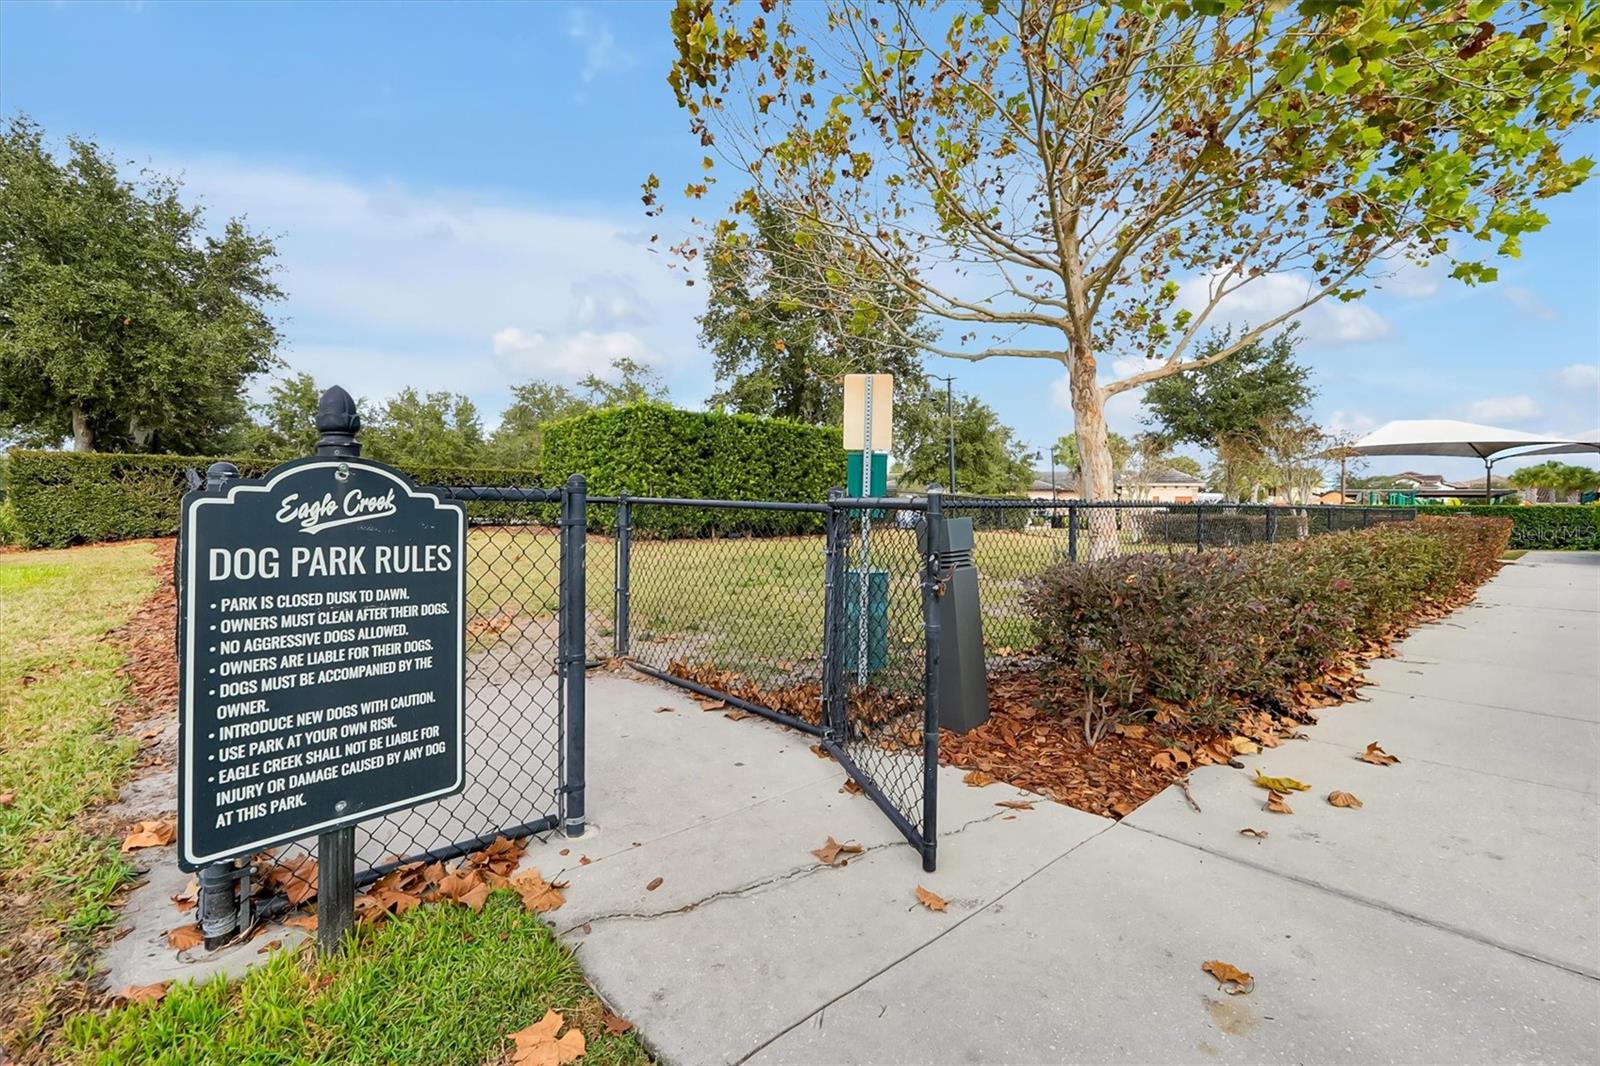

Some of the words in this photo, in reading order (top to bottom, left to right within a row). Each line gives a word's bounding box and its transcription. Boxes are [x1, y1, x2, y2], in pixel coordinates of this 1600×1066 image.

[275, 492, 338, 527] Eagle
[342, 488, 397, 517] Creek
[208, 547, 280, 581] DOG
[291, 545, 367, 578] PARK
[374, 544, 452, 575] RULES
[220, 597, 256, 613] PARK
[260, 596, 274, 610] IS
[277, 592, 323, 609] CLOSED
[325, 591, 357, 606] DUSK
[358, 590, 374, 603] TO
[375, 588, 410, 602] DAWN.
[220, 615, 278, 634] OWNERS
[280, 613, 315, 629] MUST
[317, 609, 354, 625] CLEAN
[356, 606, 388, 621] AFTER
[389, 605, 419, 618] THEIR
[420, 602, 450, 616] DOGS.
[219, 659, 277, 677] OWNERS
[280, 654, 304, 669] ARE
[307, 649, 345, 666] LIABLE
[348, 647, 370, 661] FOR
[371, 644, 402, 658] THEIR
[403, 639, 434, 655] DOGS.
[220, 639, 241, 655] NO
[243, 632, 321, 653] AGGRESSIVE
[324, 629, 356, 644] DOGS
[357, 624, 409, 641] ALLOWED.
[219, 680, 258, 698] DOGS
[261, 675, 297, 692] MUST
[299, 672, 315, 687] BE
[317, 662, 396, 685] ACCOMPANIED
[398, 657, 413, 673] BY
[414, 654, 433, 669] THE
[216, 699, 270, 720] OWNER.
[219, 715, 294, 742] INTRODUCE
[296, 709, 324, 725] NEW
[326, 704, 358, 722] DOGS
[360, 699, 389, 715] WITH
[390, 691, 436, 710] CAUTION.
[218, 765, 260, 785] EAGLE
[263, 754, 303, 775] CREEK
[305, 747, 343, 767] SHALL
[344, 741, 367, 756] NOT
[369, 736, 384, 751] BE
[385, 730, 419, 748] LIABLE
[420, 725, 440, 739] FOR
[219, 745, 246, 763] USE
[249, 739, 284, 757] PARK
[286, 736, 302, 749] AT
[304, 730, 338, 747] YOUR
[340, 723, 368, 739] OWN
[369, 716, 398, 732] RISK.
[216, 783, 264, 807] INJURY
[267, 777, 286, 792] OR
[288, 766, 339, 789] DAMAGE
[340, 756, 385, 776] CAUSED
[387, 753, 401, 766] BY
[402, 747, 423, 763] ANY
[425, 741, 446, 757] DOG
[216, 811, 235, 829] AT
[236, 803, 267, 824] THIS
[270, 793, 307, 815] PARK.
